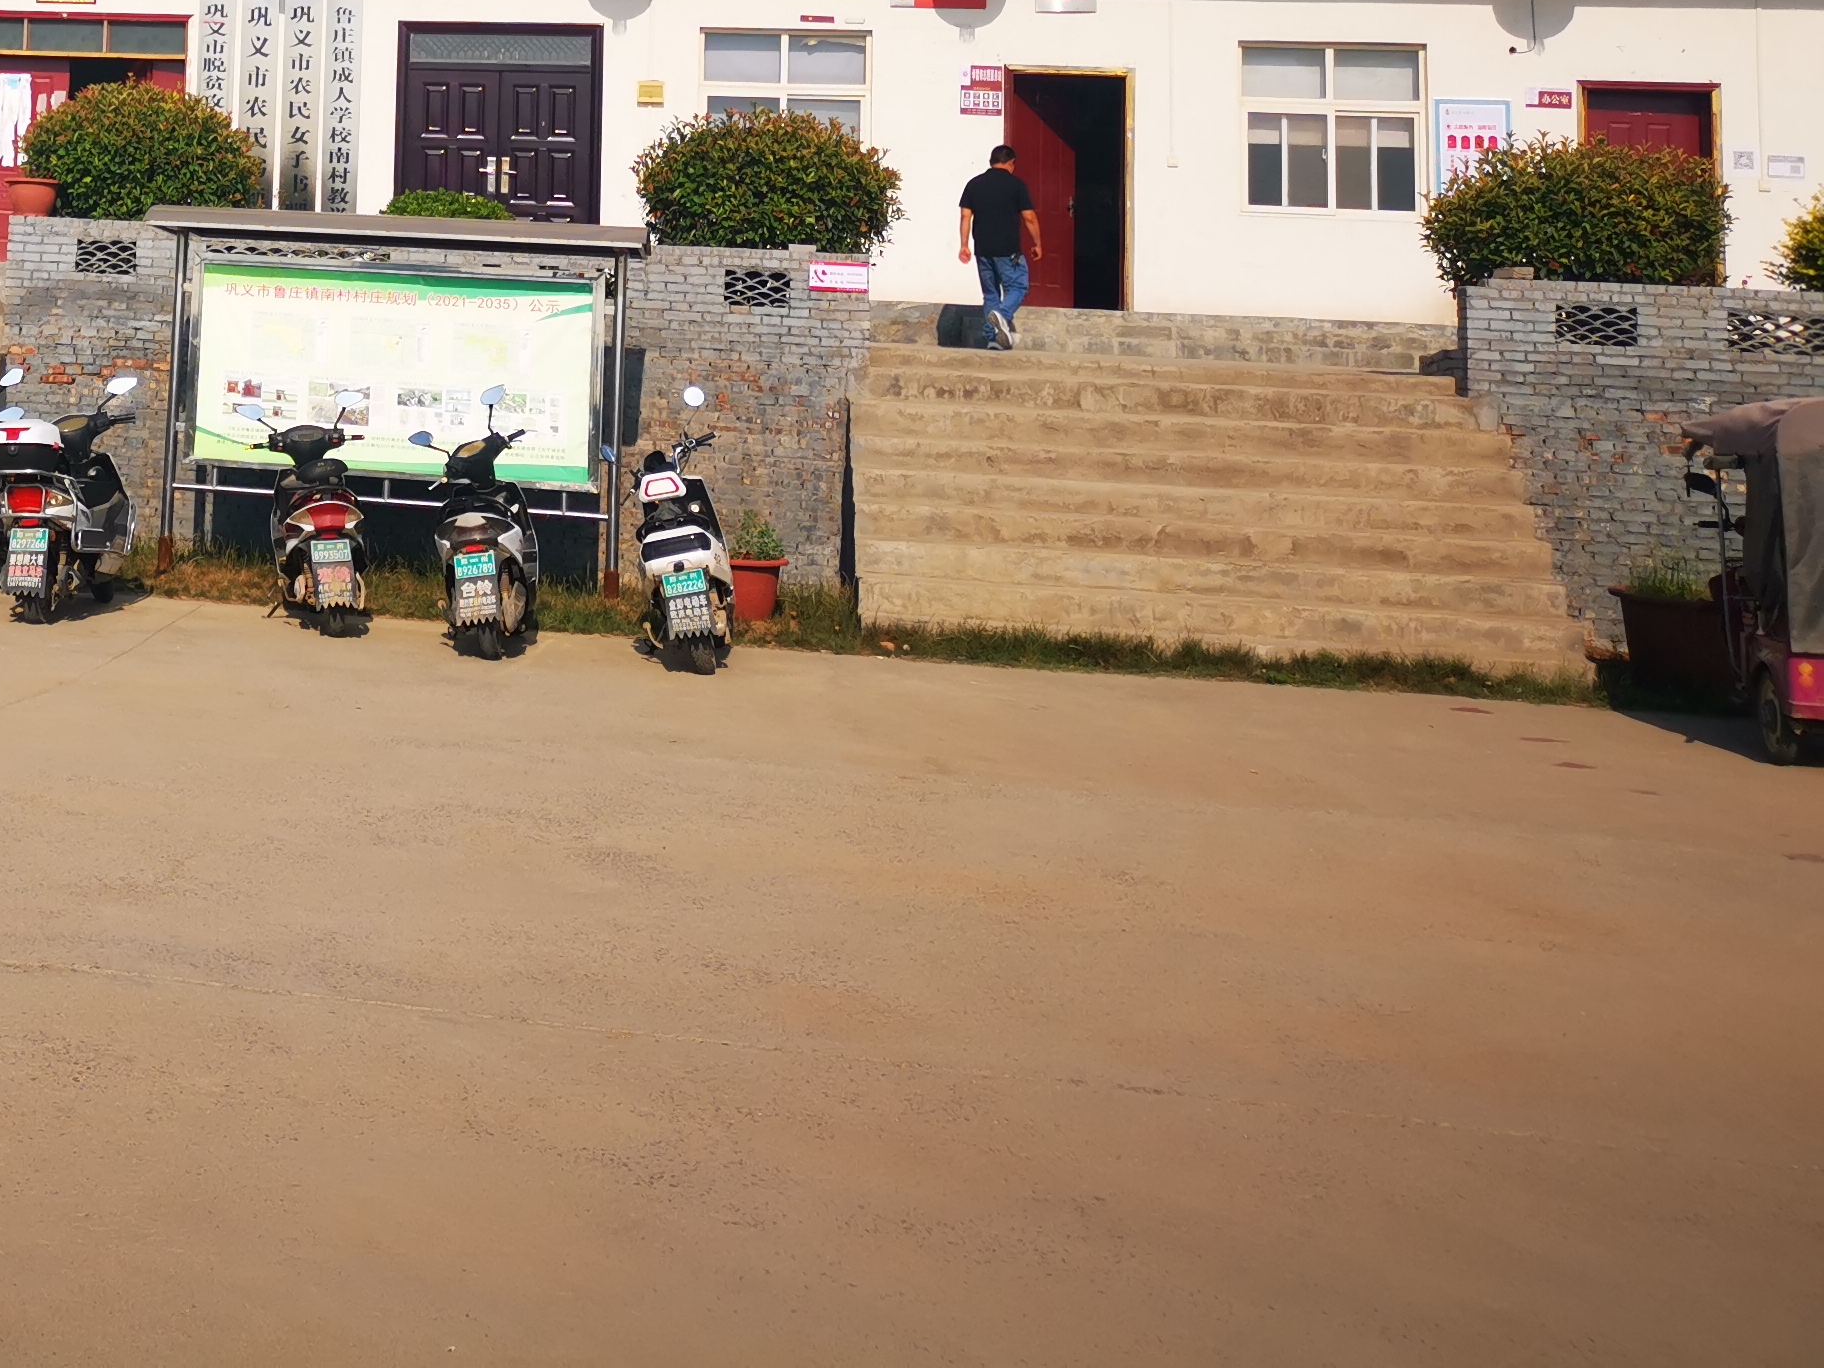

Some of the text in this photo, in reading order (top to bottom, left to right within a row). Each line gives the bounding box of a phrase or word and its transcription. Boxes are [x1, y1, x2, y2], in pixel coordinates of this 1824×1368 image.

[1541, 93, 1570, 106] 办公室
[11, 538, 45, 549] 8297266
[313, 549, 348, 561] 8993507
[460, 579, 493, 598] 台铃
[666, 579, 704, 594] 8282226
